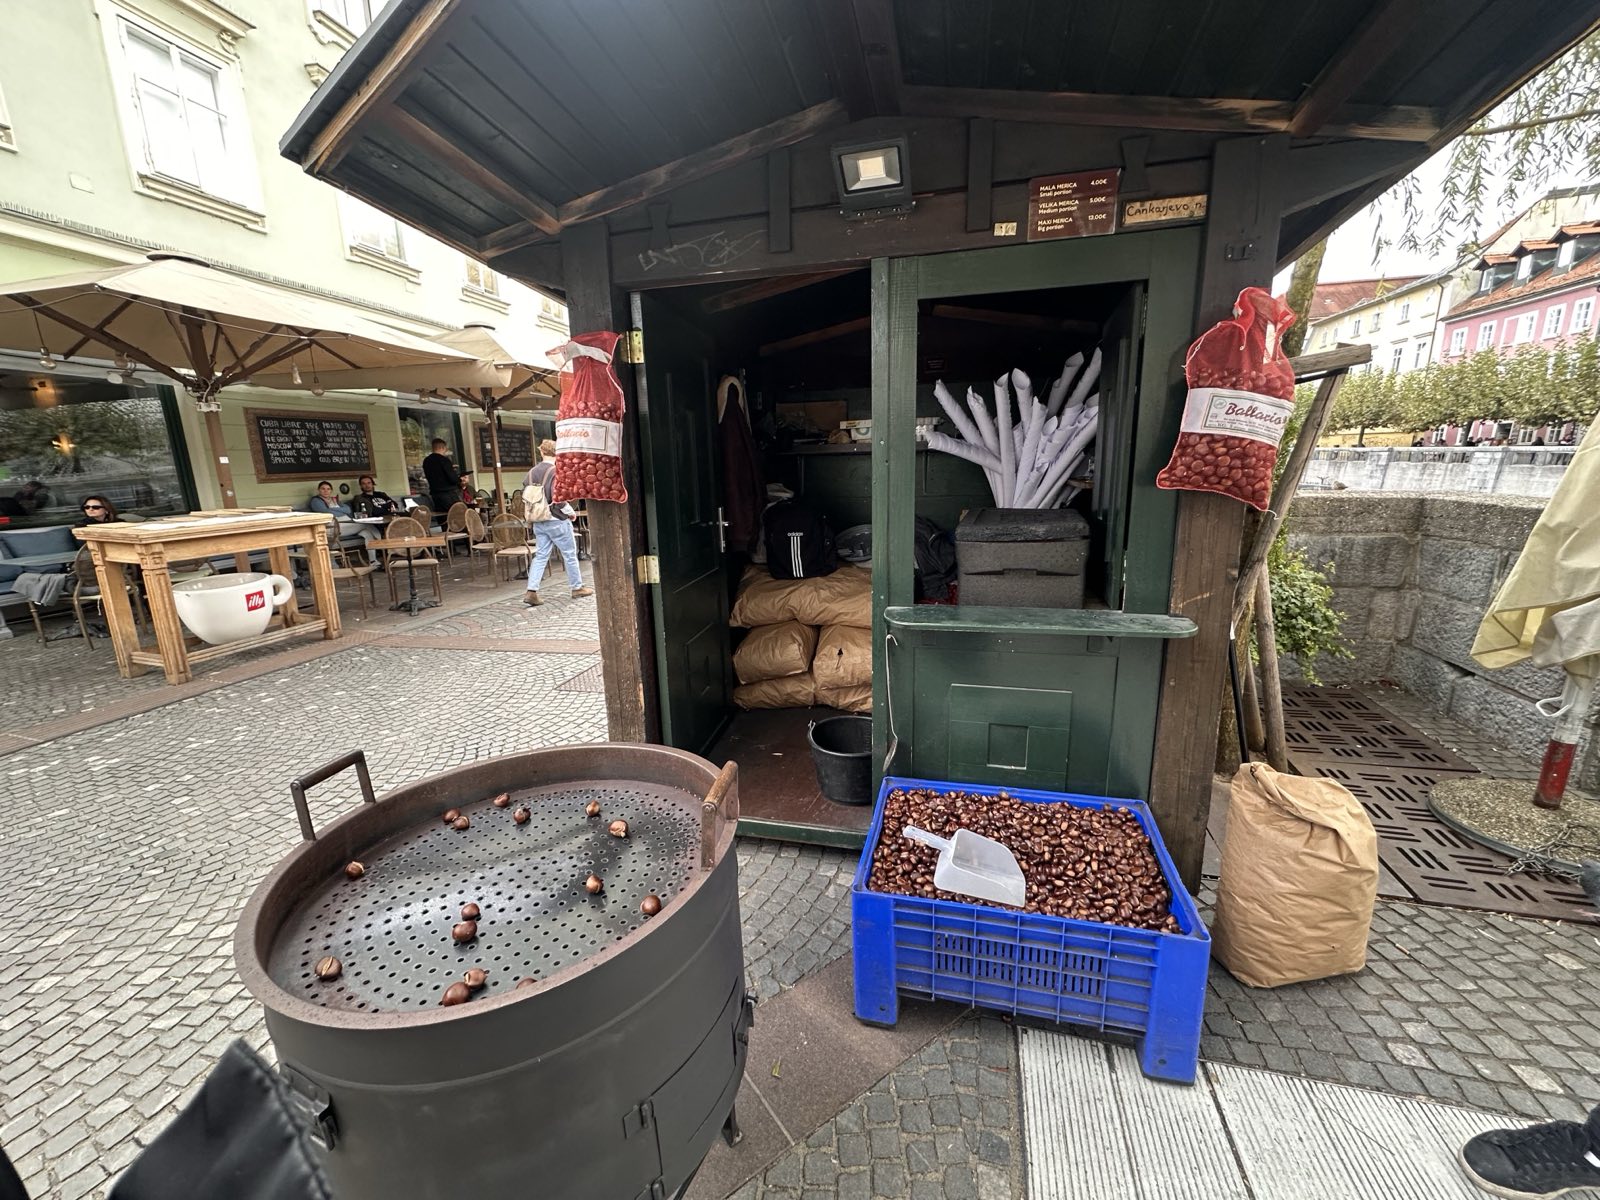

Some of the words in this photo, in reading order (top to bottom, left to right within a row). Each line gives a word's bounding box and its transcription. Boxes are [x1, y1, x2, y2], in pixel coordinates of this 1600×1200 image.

[1057, 182, 1077, 190] MERICA
[1054, 189, 1073, 197] portion
[1058, 199, 1079, 207] MERICA
[1039, 207, 1058, 215] Medium
[1058, 205, 1078, 214] portion
[1126, 202, 1189, 217] Cankarjevo
[1052, 217, 1073, 225] MERICA
[1037, 225, 1045, 233] Big
[1045, 224, 1065, 232] portion
[260, 419, 279, 428] CUBA
[282, 421, 301, 429] LIBRE
[266, 442, 291, 450] MOSCOW
[248, 594, 264, 608] illy
